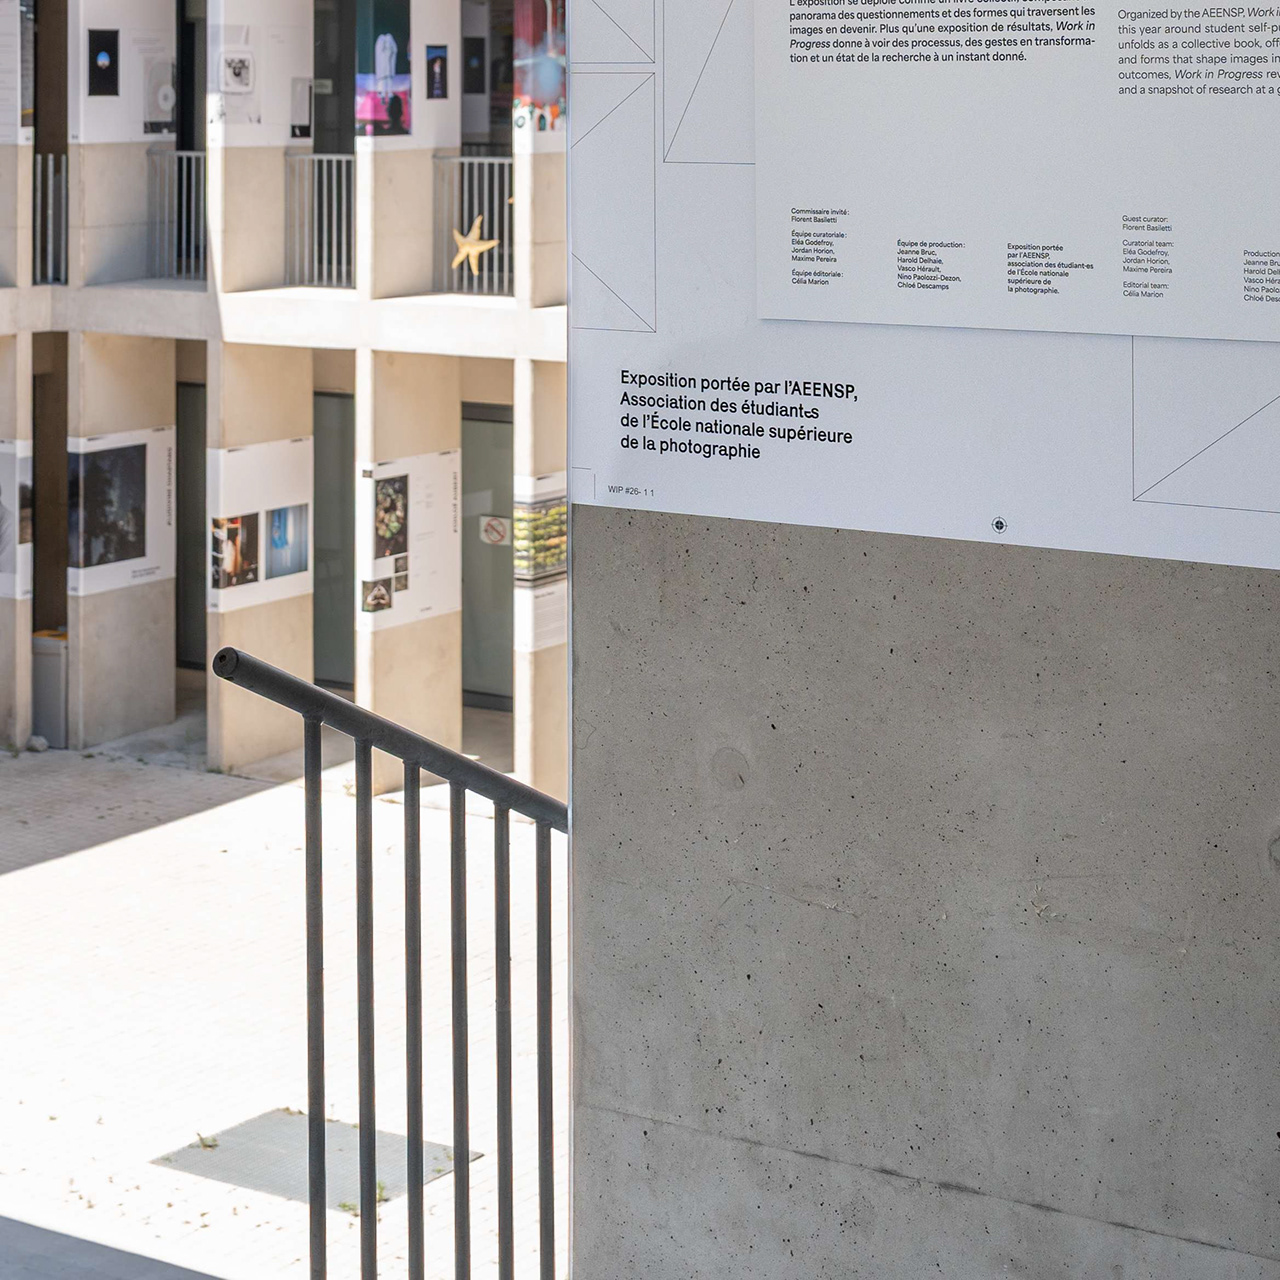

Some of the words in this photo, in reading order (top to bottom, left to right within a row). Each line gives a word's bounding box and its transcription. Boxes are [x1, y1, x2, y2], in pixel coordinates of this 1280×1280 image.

[896, 248, 920, 256] Jeanne
[620, 369, 697, 389] Exposition
[700, 376, 751, 393] portée
[754, 381, 782, 397] par
[619, 391, 706, 414] Association
[709, 397, 738, 414] des
[620, 412, 639, 428] de
[695, 419, 765, 438] nationale
[768, 425, 853, 444] supérieure
[620, 434, 639, 450] de
[642, 435, 657, 451] la
[659, 437, 761, 461] photographie
